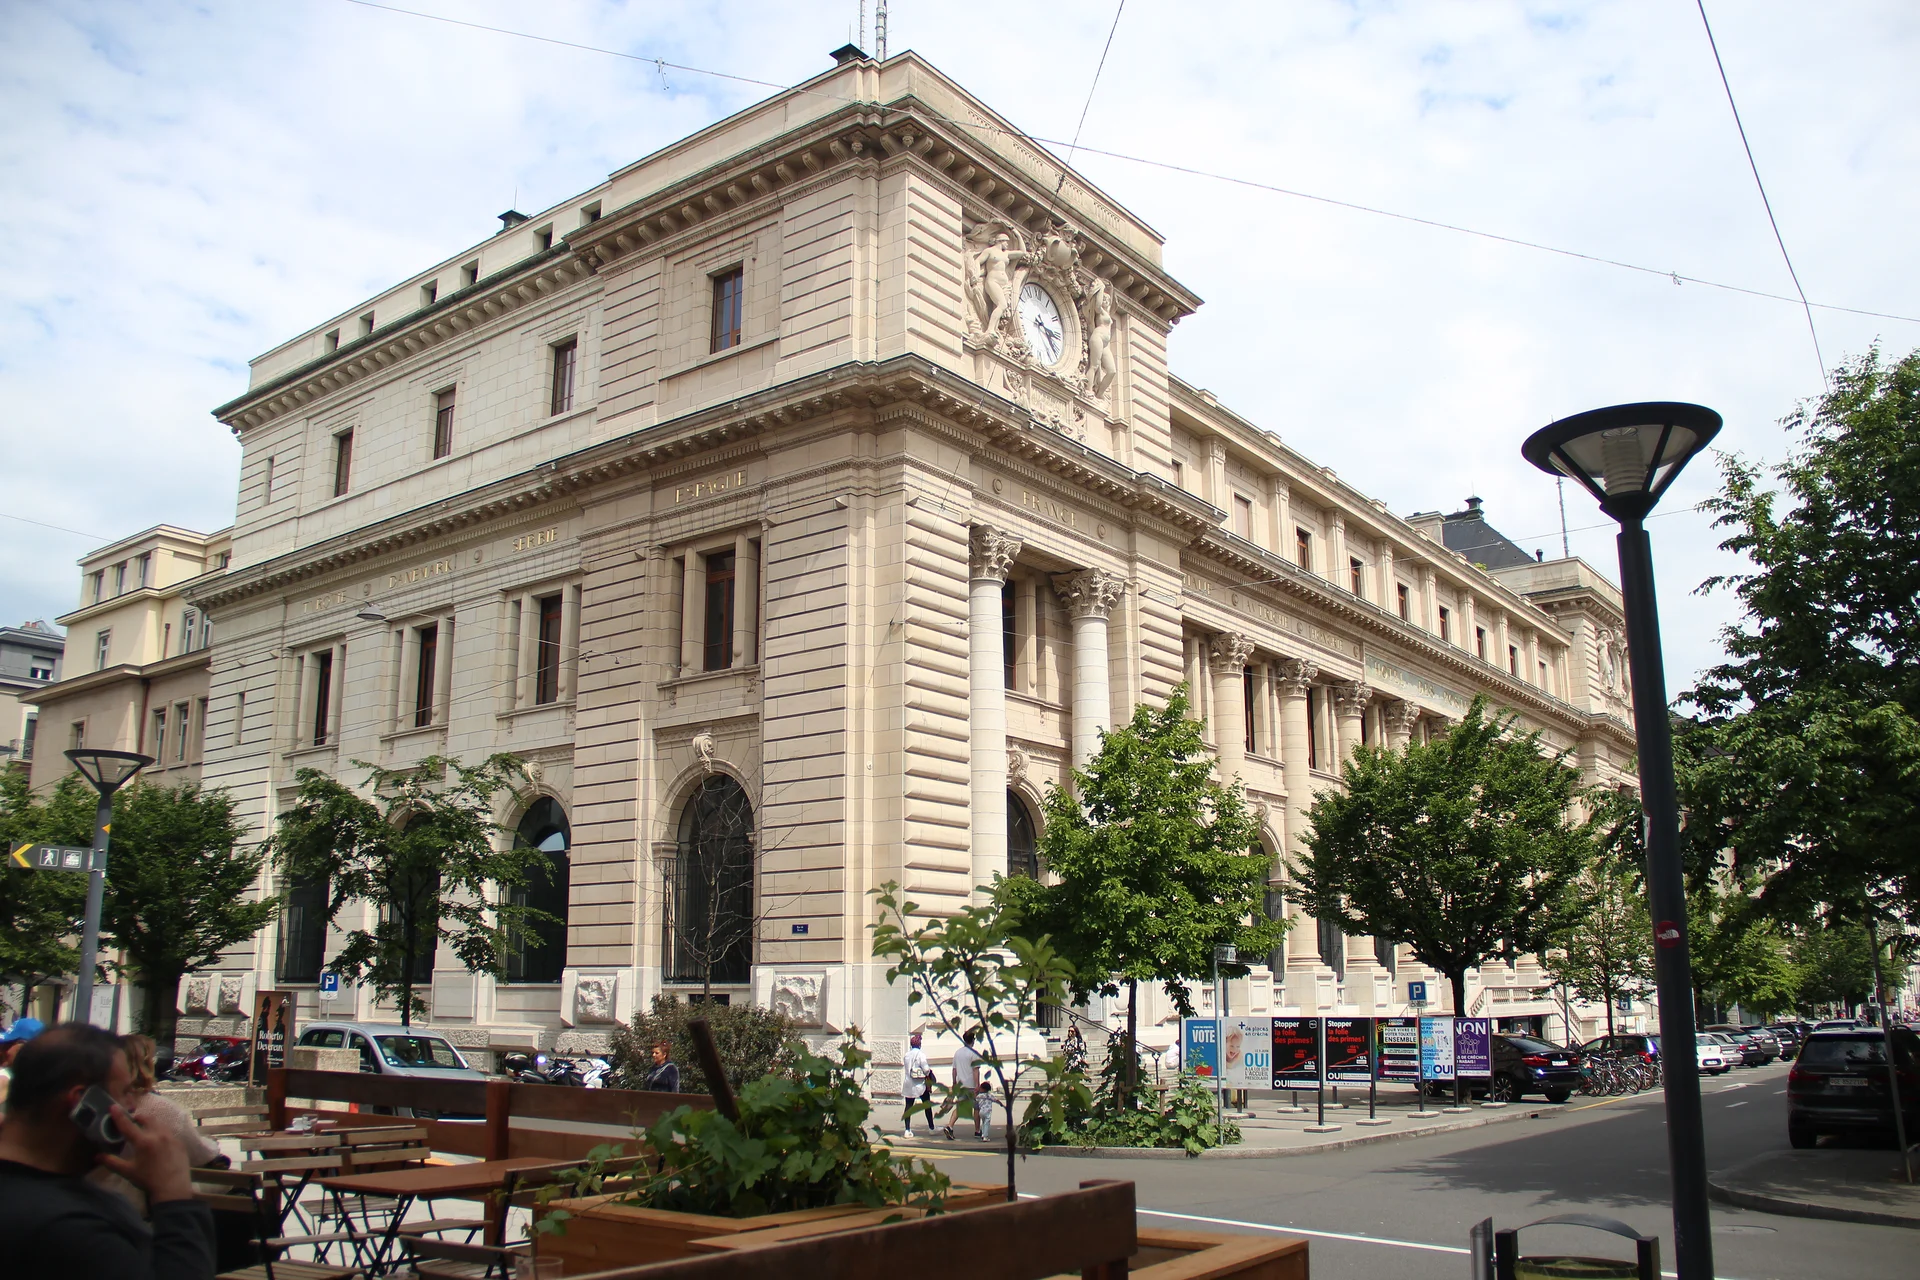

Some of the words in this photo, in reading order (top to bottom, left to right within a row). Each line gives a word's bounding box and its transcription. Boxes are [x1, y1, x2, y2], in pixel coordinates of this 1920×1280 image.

[1023, 490, 1077, 527] FRANCE
[512, 526, 558, 553] SERBIE
[389, 559, 453, 588] DANEMARK
[325, 975, 335, 989] P
[1413, 985, 1422, 998] P
[1274, 1020, 1300, 1029] Stopper
[1328, 1020, 1352, 1029] Stopper
[259, 1030, 283, 1041] Roberto
[1192, 1030, 1215, 1043] VOTE
[1287, 1037, 1309, 1045] primes
[1244, 1052, 1269, 1067] OUI
[1433, 1065, 1453, 1074] OUI
[1327, 1072, 1343, 1080] OUI
[1274, 1080, 1290, 1088] OUI
